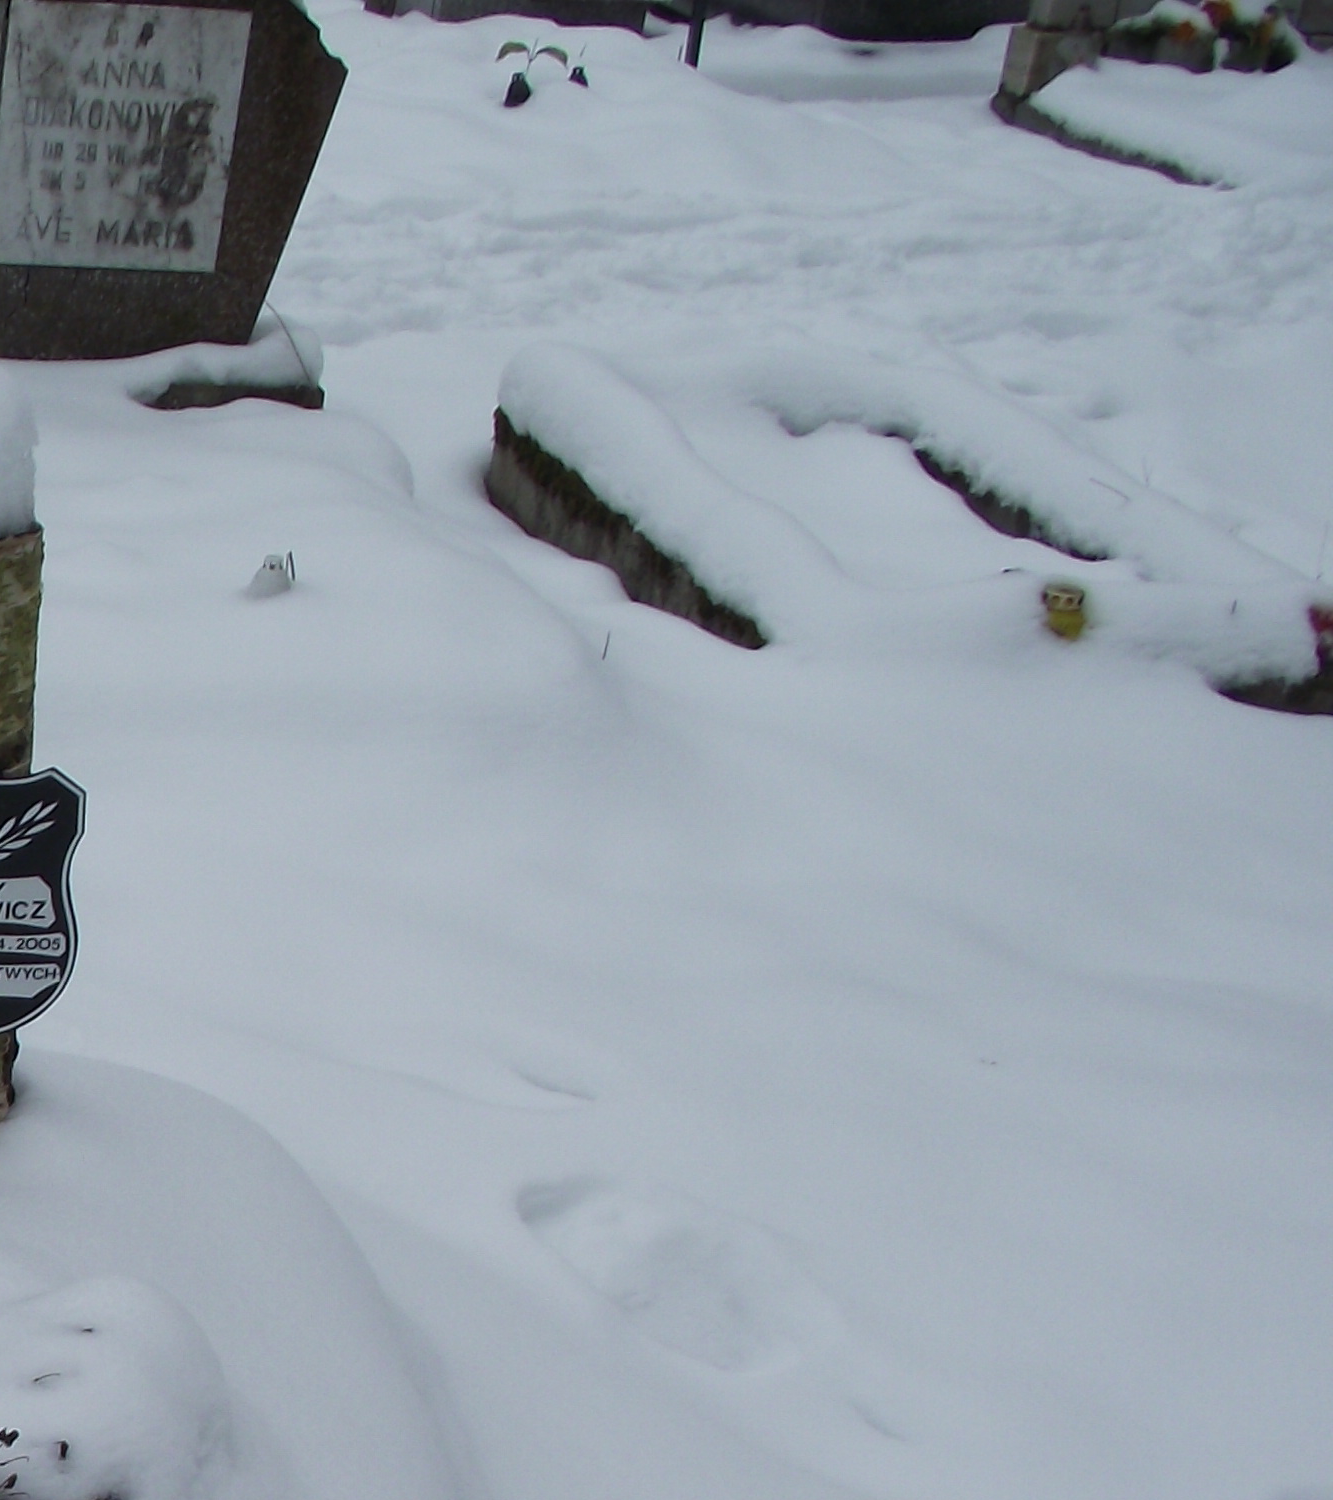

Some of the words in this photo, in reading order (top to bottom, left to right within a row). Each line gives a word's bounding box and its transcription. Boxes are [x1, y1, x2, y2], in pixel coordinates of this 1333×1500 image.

[82, 60, 165, 89] ANNA
[17, 212, 73, 243] AVE
[96, 219, 195, 249] MARIA
